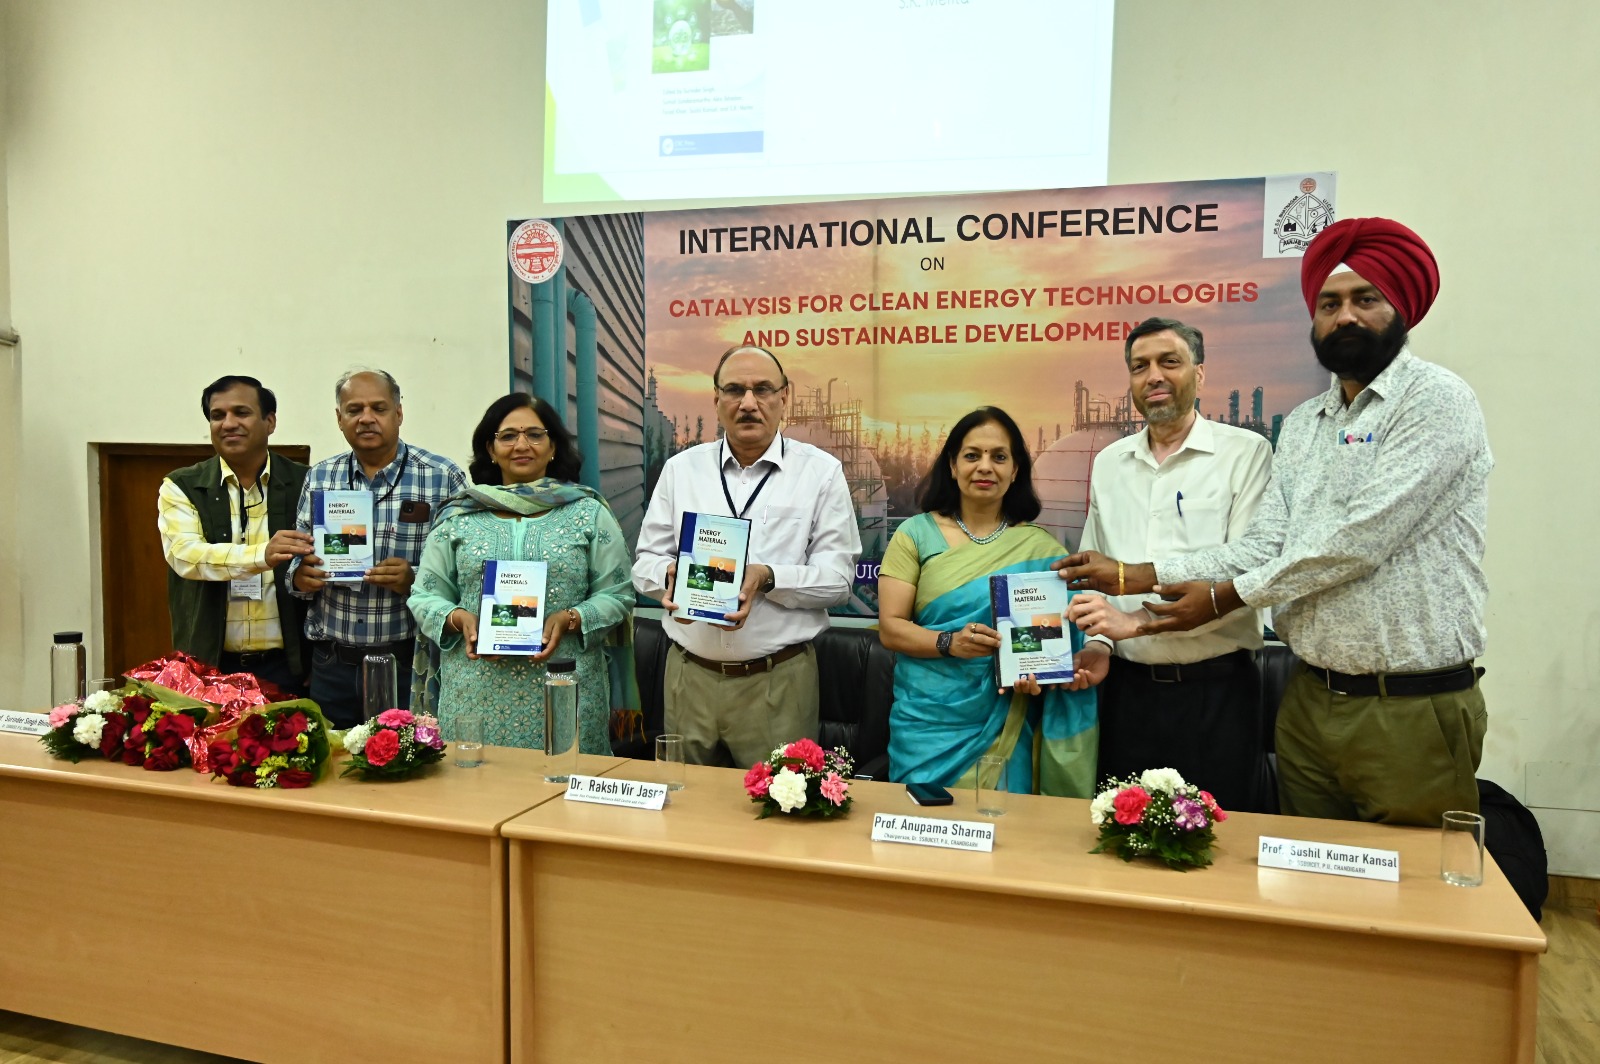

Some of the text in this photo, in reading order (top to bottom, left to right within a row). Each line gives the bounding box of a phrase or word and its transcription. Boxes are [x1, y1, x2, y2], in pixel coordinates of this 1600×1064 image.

[680, 203, 1219, 255] INTERNATIONAL CONFERENCE
[920, 257, 945, 271] ON
[669, 282, 1258, 318] CATALYSIS FOR CLEAN ENERGY TECHNOLOGIES
[742, 321, 1139, 347] AND SUSTAINABLE DEVELOPMEN
[698, 528, 722, 537] ENERGY
[697, 536, 727, 546] MATERIALS
[1013, 587, 1038, 596] ENERGY
[1014, 594, 1047, 603] MATERIALS
[570, 777, 583, 791] Dr.
[588, 779, 618, 795] Raksh
[621, 782, 635, 796] Vir
[874, 815, 992, 840] Prof. Anupama Sharma
[1261, 842, 1397, 868] Prof. Sushil Kumar Kansal
[1333, 864, 1366, 874] CHANDIGARH
